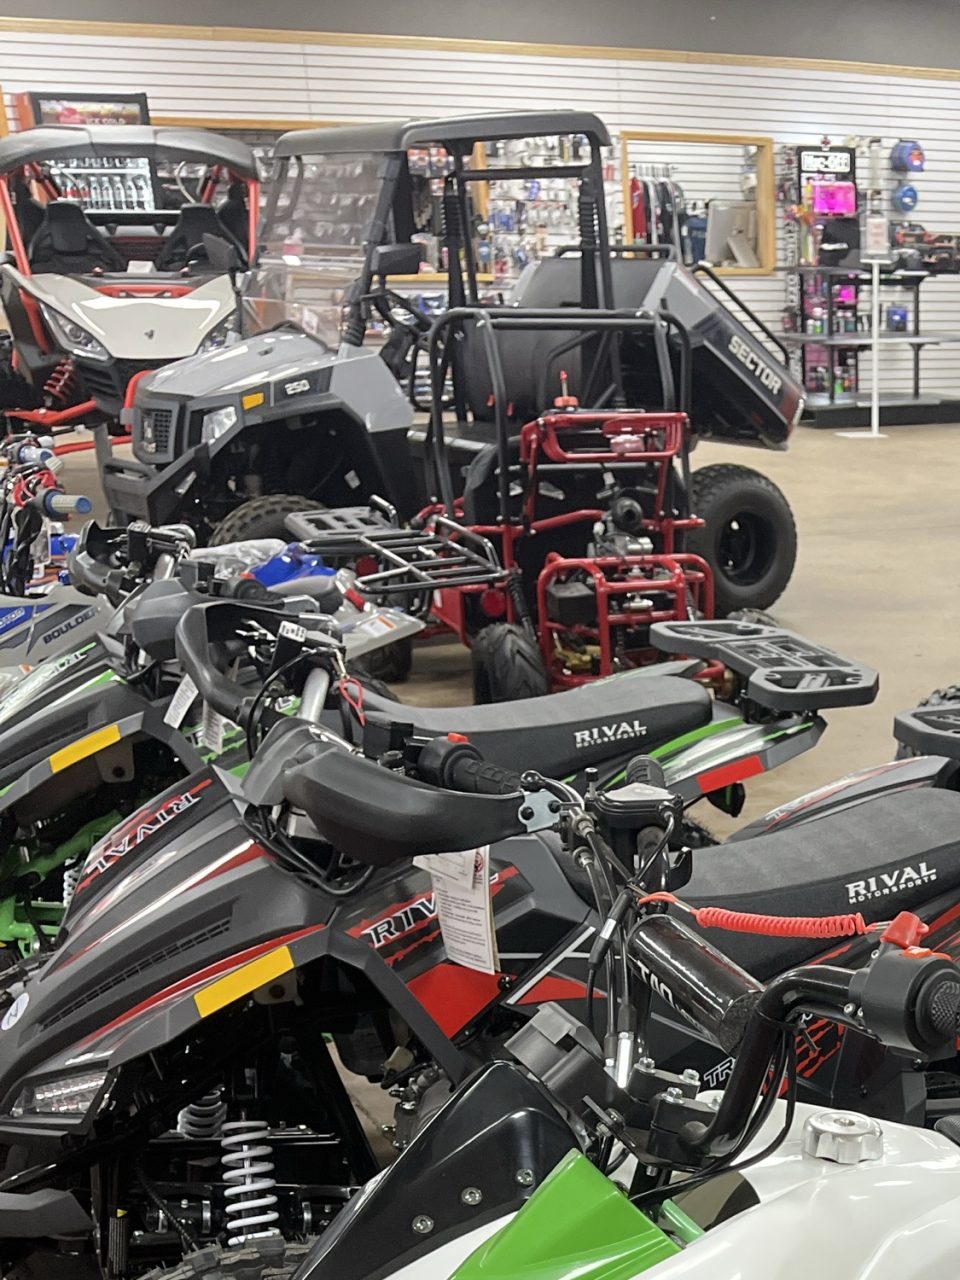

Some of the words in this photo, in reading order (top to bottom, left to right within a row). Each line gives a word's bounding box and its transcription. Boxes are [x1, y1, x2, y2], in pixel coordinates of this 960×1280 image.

[728, 335, 782, 395] SECTOR
[573, 720, 648, 743] RIVAL
[84, 792, 202, 874] RIVAL
[844, 862, 937, 898] RIVAL
[848, 873, 937, 905] MOTORSPORTS
